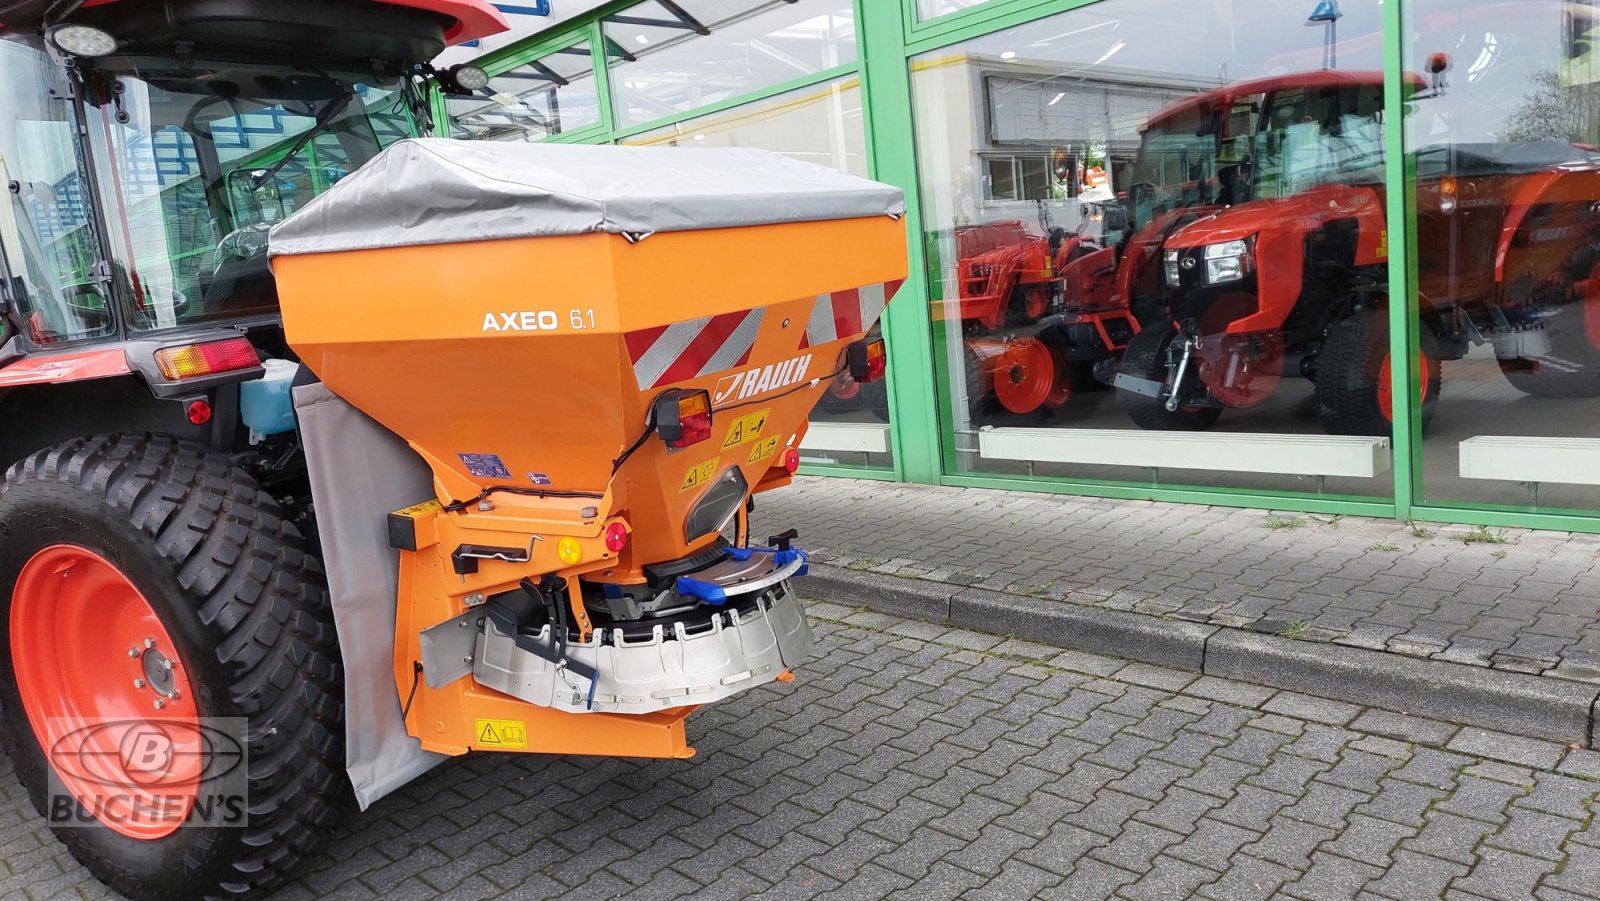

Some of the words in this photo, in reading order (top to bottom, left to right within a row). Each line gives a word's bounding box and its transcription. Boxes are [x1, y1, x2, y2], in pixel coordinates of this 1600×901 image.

[482, 310, 558, 331] AXEO
[569, 309, 595, 329] 6.1
[738, 353, 812, 400] RAUCH
